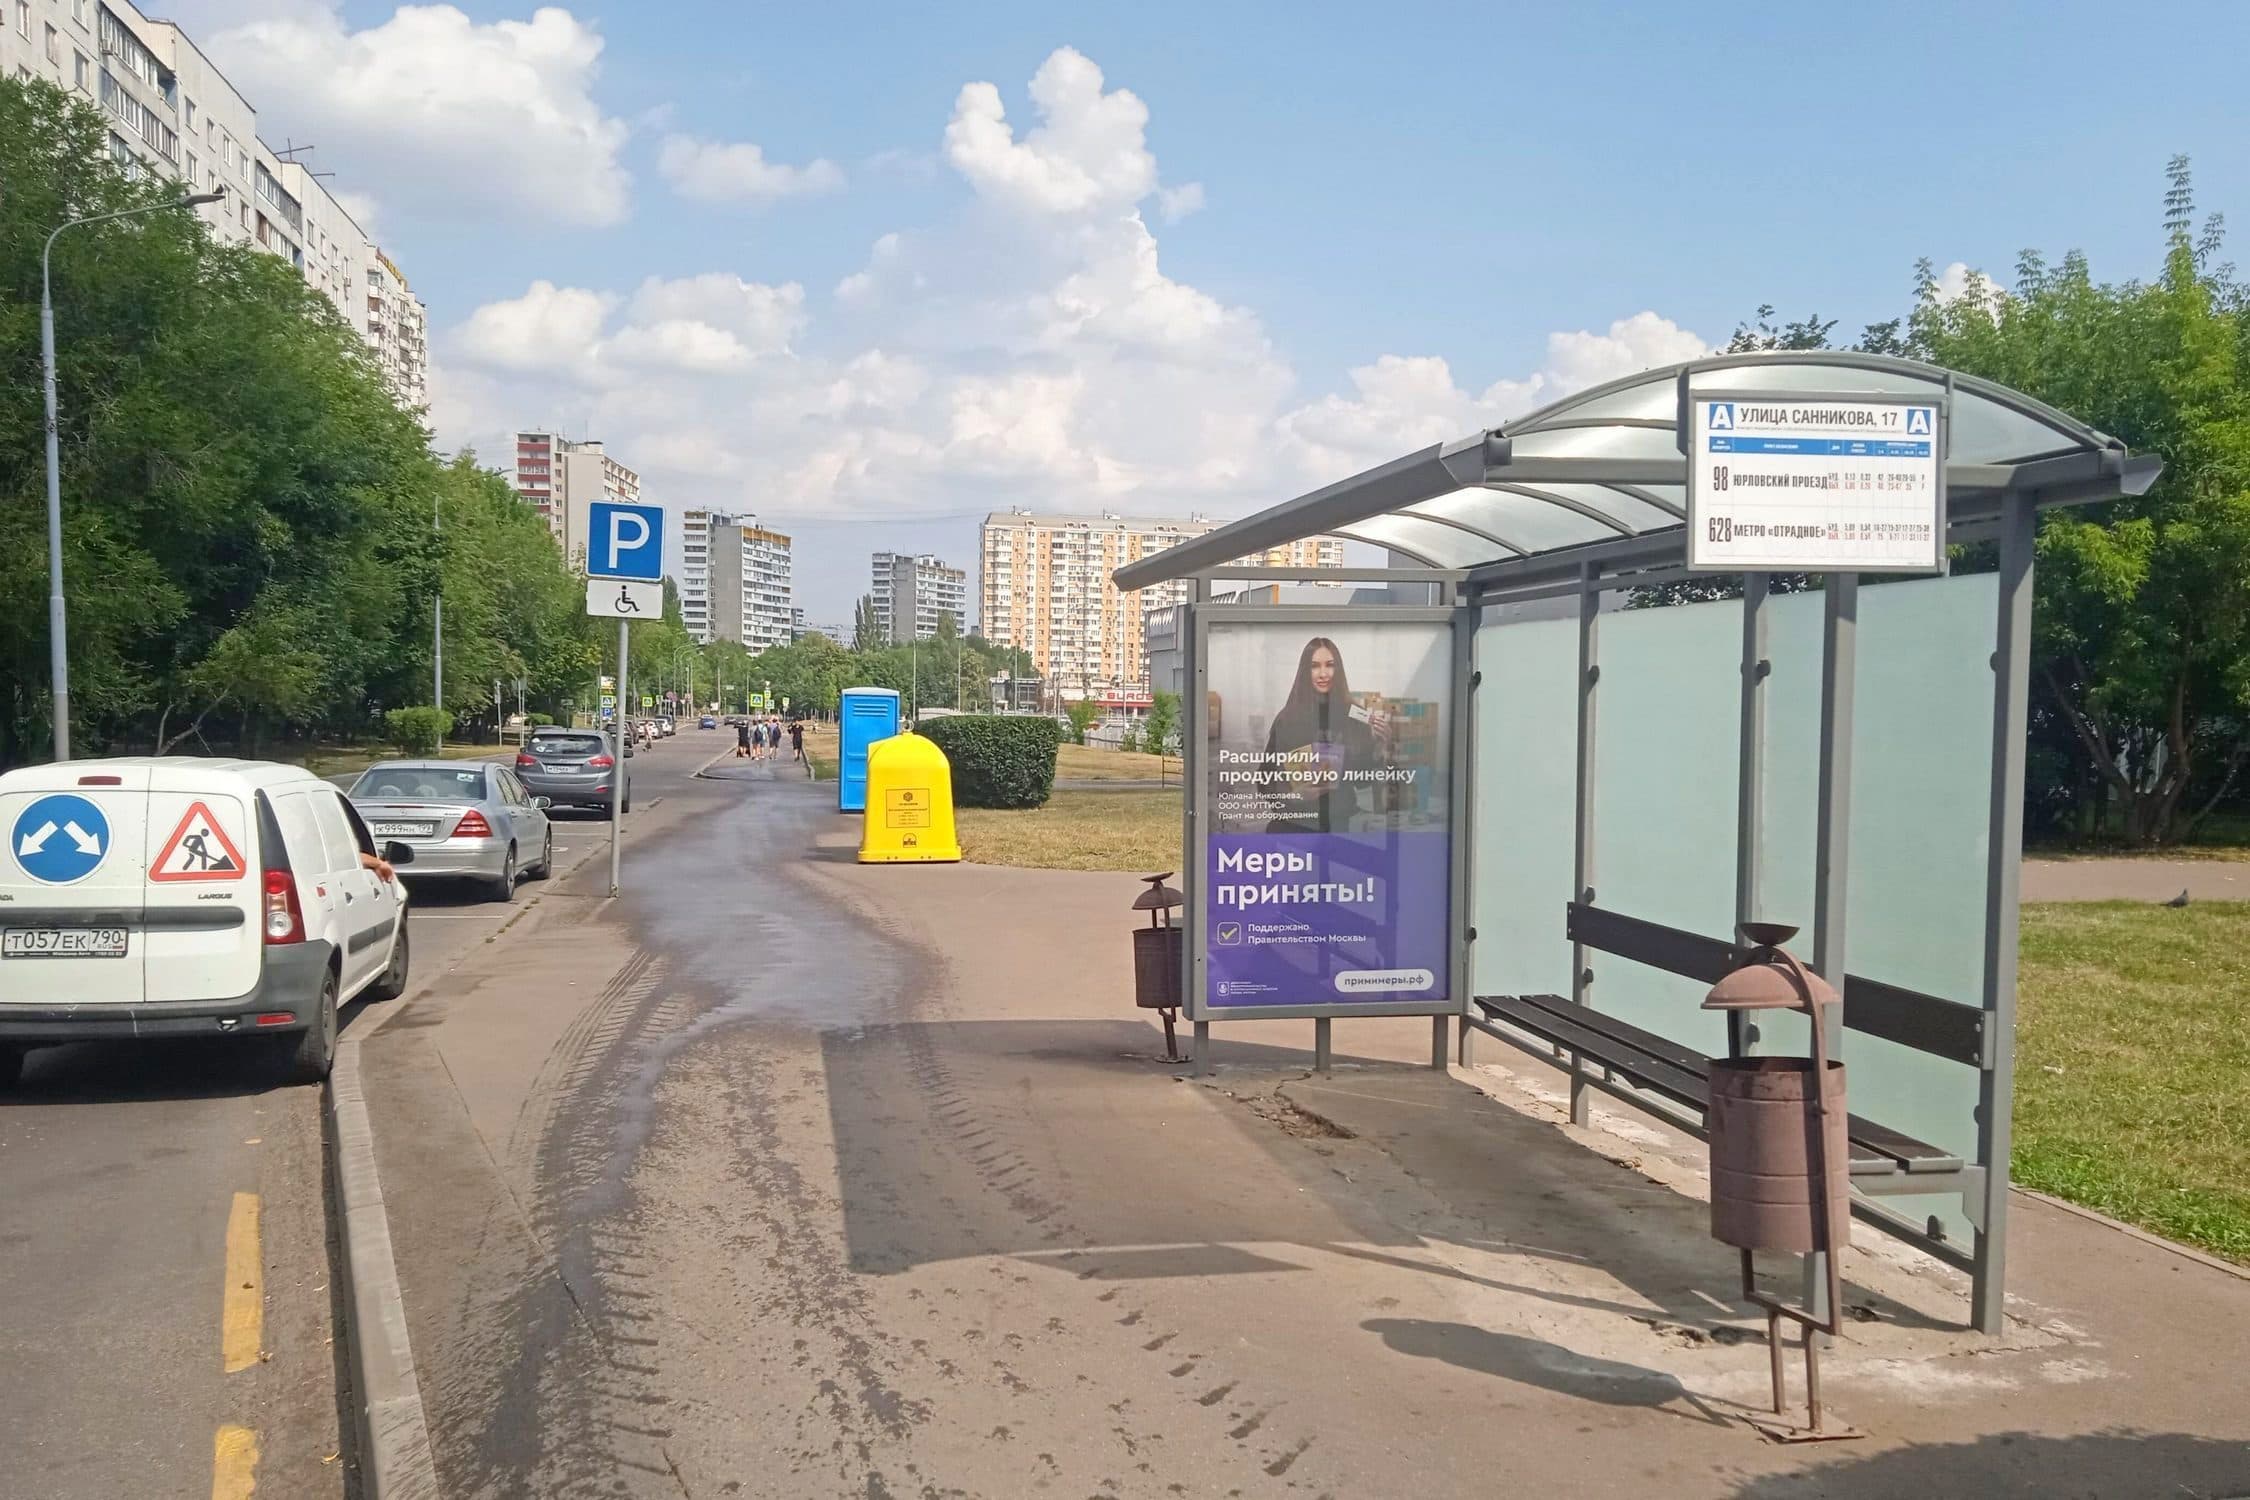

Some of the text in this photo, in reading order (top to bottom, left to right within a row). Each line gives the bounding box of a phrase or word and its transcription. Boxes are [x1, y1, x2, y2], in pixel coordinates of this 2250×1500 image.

[1741, 408, 1898, 427] УЛИЦА САННИКОВА, 17
[1713, 466, 1728, 491] 98
[1733, 473, 1790, 487] ЮРЛОВСКИЙ
[1792, 476, 1828, 490] ПРОЕЗД
[1709, 517, 1732, 542] 628
[1734, 524, 1766, 537] МЕТРО
[1768, 525, 1826, 539] «ОТРАДНОЕ»
[608, 511, 650, 569] P
[1219, 750, 1320, 768] Расширили
[1219, 765, 1416, 786] продуктовую линейку
[1218, 791, 1304, 801] Юлиана Николаева,
[1218, 801, 1286, 810] ООО «НУТТИС»
[1218, 811, 1242, 821] Грант
[1256, 810, 1319, 821] оборудование
[1218, 848, 1313, 878] Меры
[1218, 878, 1375, 910] приняты!
[1248, 923, 1310, 933] Поддержано
[12, 930, 121, 949] Т057ЕК 790
[1248, 934, 1367, 945] Правительством Москвы
